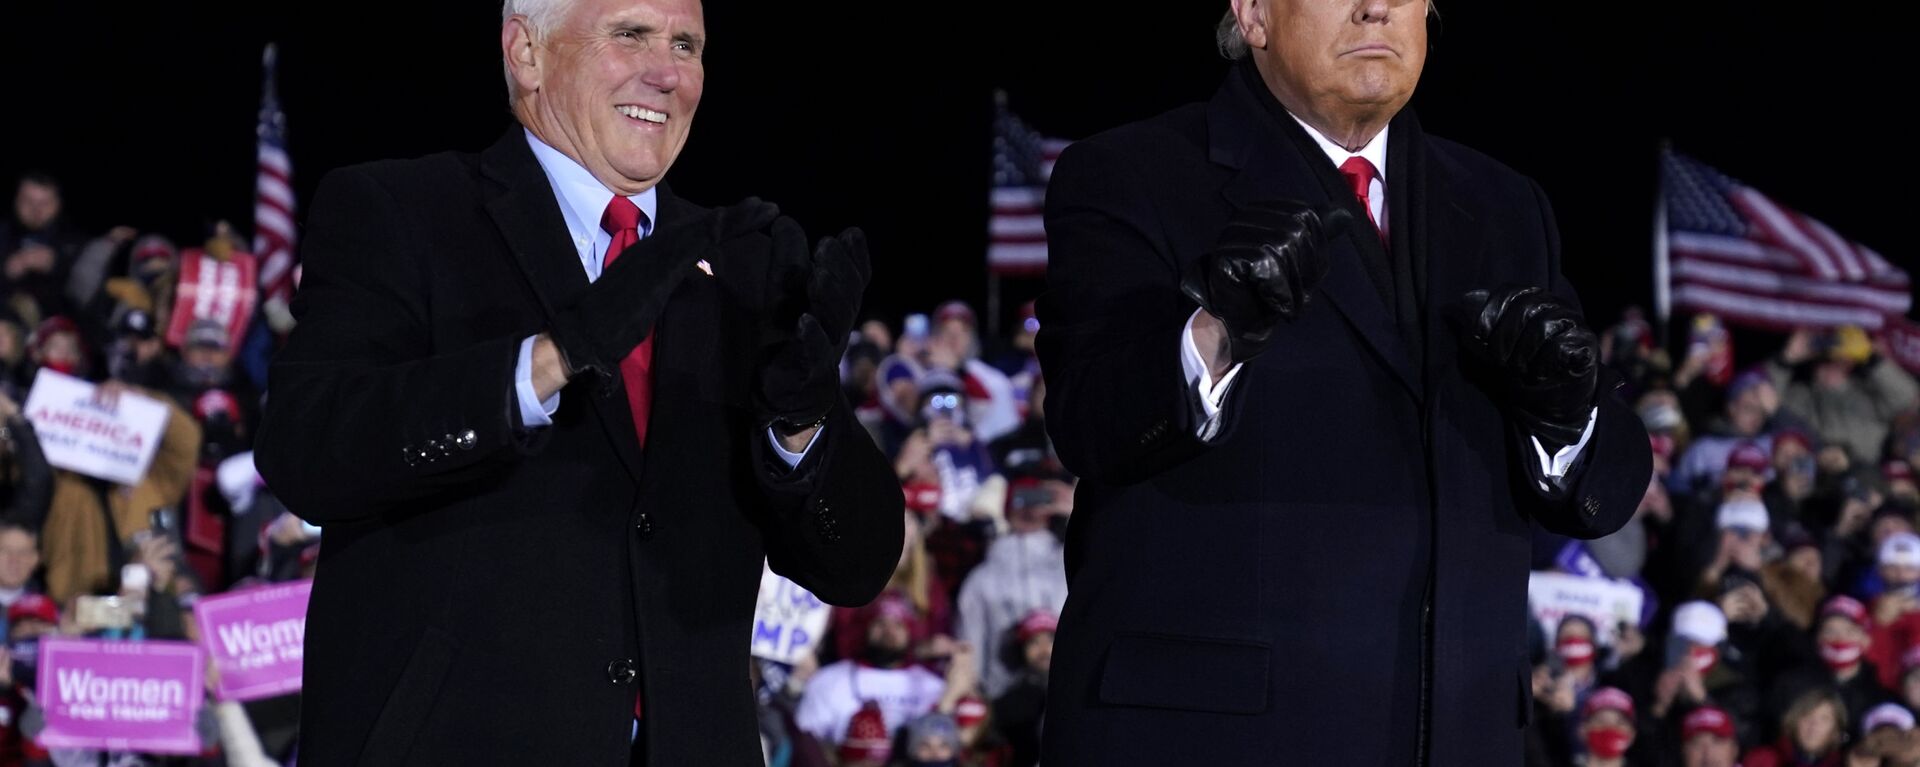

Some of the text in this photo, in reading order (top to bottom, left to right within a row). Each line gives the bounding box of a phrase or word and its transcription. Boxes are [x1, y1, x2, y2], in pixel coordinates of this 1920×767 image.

[34, 406, 143, 450] AMERICA
[219, 618, 305, 657] Wom
[240, 652, 276, 670] FOR
[57, 667, 184, 708] Women
[69, 704, 169, 722] FOR TRUMP
